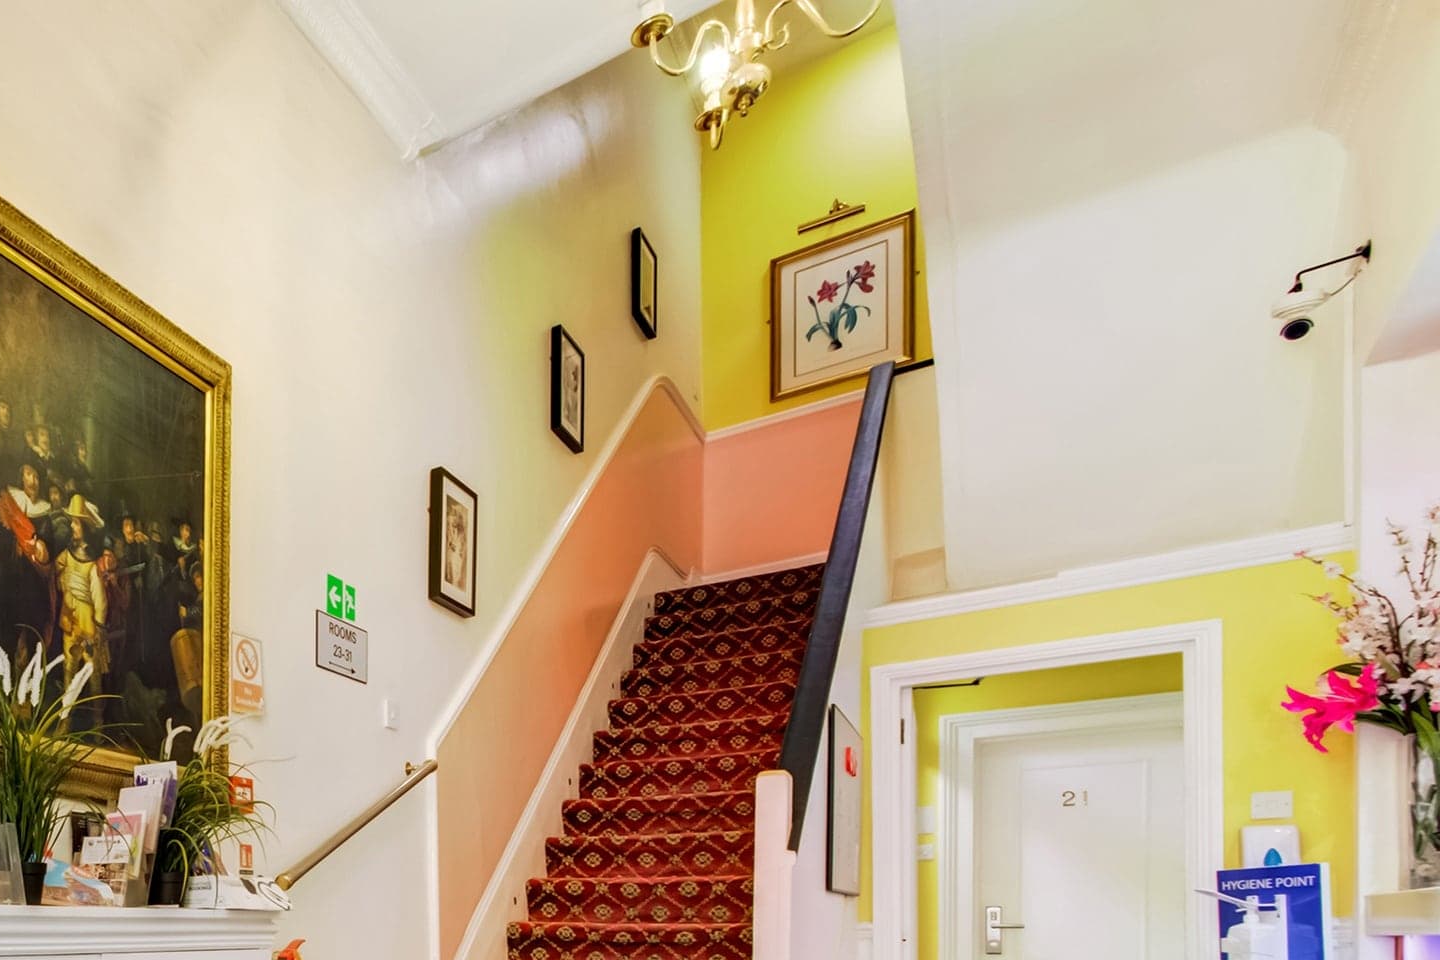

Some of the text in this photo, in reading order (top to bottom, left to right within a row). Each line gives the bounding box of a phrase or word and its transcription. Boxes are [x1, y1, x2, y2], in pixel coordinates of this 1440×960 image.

[329, 622, 357, 644] ROOMS
[333, 644, 352, 662] 23-31
[1222, 876, 1316, 891] HYGIENE POINT
